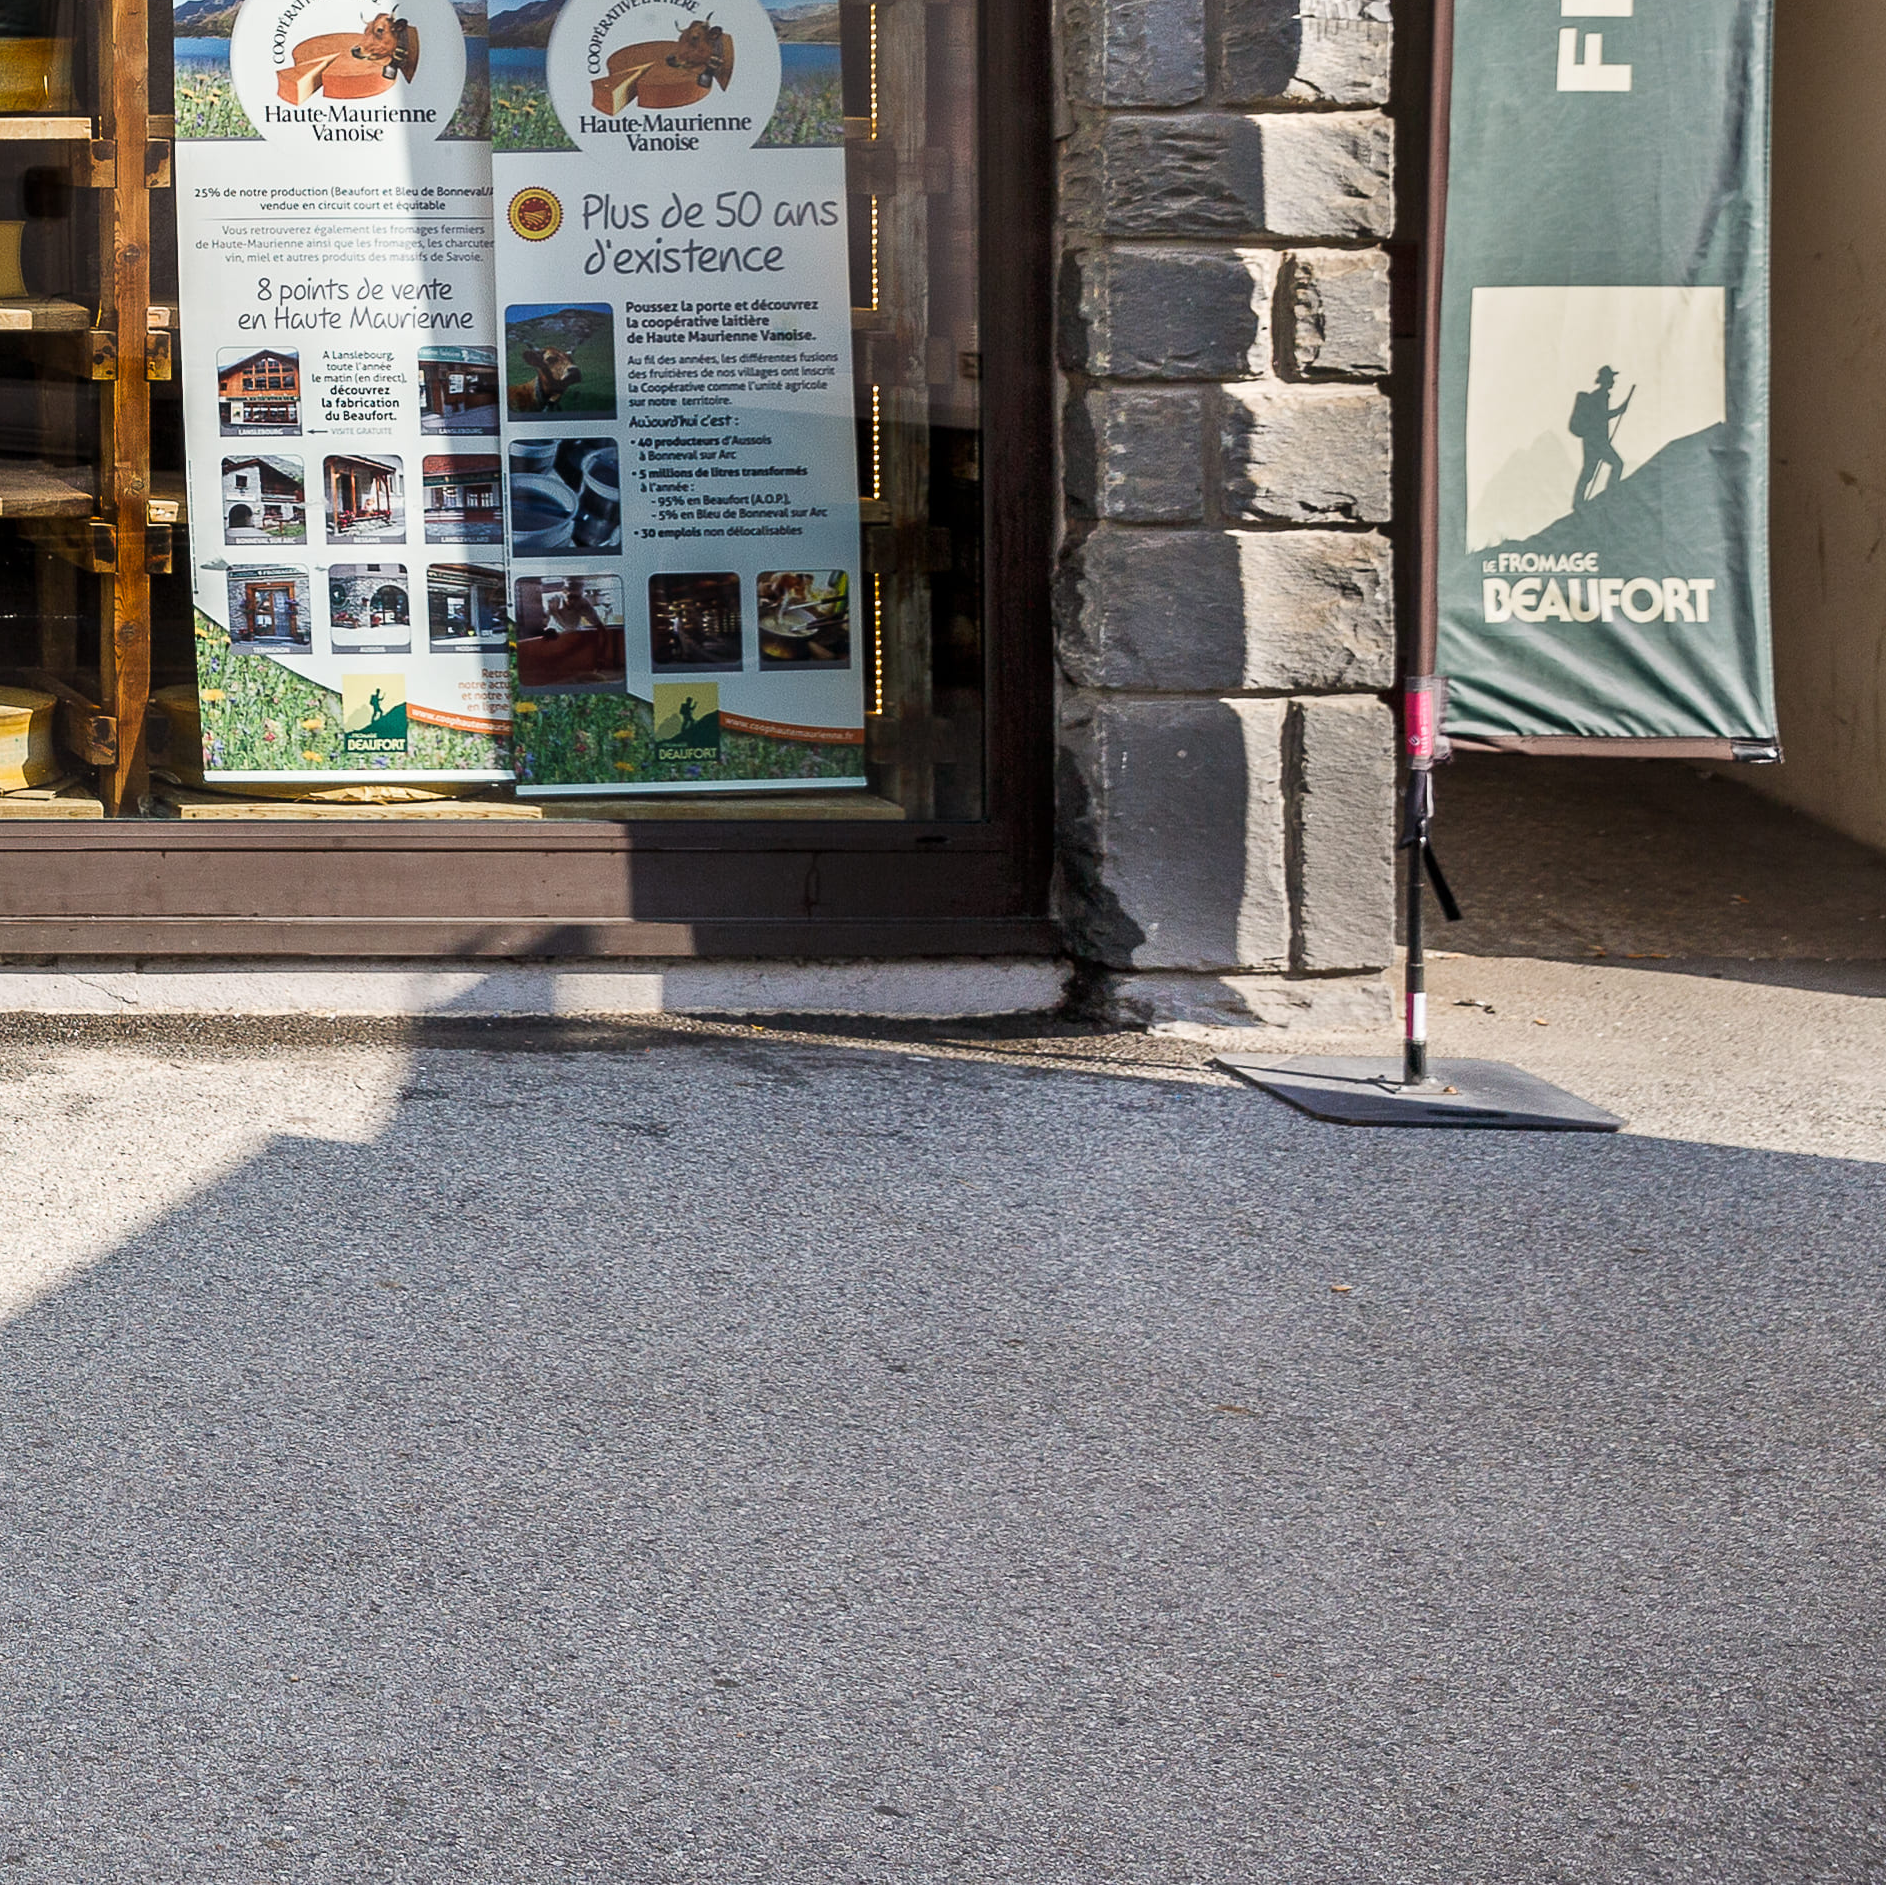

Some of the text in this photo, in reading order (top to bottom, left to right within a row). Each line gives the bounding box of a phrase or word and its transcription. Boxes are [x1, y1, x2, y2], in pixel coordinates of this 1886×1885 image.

[266, 106, 436, 122] Haute-Maurienne
[580, 115, 751, 132] Haute-Maurienne
[313, 125, 384, 141] Vanoise
[626, 135, 699, 151] Vanoise
[194, 188, 220, 197] 25%
[224, 188, 237, 197] de
[240, 189, 268, 197] notre
[271, 188, 328, 199] production
[331, 187, 379, 197] (Beaufort
[383, 188, 392, 196] et
[396, 187, 418, 196] Bleu
[421, 187, 434, 196] de
[260, 200, 445, 212] vendue en circuit court et équitable
[583, 191, 839, 230] Plus de 50 ans
[222, 224, 485, 237] Vous retrouverez également les fromages fermiers
[196, 240, 209, 249] de
[212, 239, 303, 249] Haute-Maurienne
[306, 239, 331, 248] ainsi
[334, 240, 353, 250] que
[356, 239, 371, 248] les
[374, 239, 424, 250] fromages,
[428, 238, 442, 248] les
[225, 252, 483, 264] vin, miel et autres produits des massifs de Savoie.
[584, 237, 784, 274] d'existence
[257, 277, 452, 306] 8 points de vente
[626, 299, 818, 315] Poussez la porte et découvrez
[238, 306, 473, 330] en Haute Maurienne
[627, 313, 769, 331] la coopérative laitière
[627, 330, 816, 343] de Haute Maurienne Vanoise.
[323, 350, 394, 361] A Lanslebourg,
[628, 352, 838, 365] Au fil des années, les différentes fusions
[327, 362, 391, 371] toute l'année
[312, 374, 321, 382] le
[355, 374, 370, 384] (en
[330, 385, 390, 395] découvrez
[629, 383, 638, 393] la
[641, 382, 704, 394] Coopérative
[707, 383, 745, 391] comme
[785, 380, 827, 392] agricole
[322, 398, 399, 408] la fabrication
[629, 396, 732, 407] sur notre territoire.
[325, 411, 397, 420] du Beaufort.
[629, 415, 731, 428] Aujourd'hui c'est
[638, 436, 771, 449] 40 producteurs d'Aussois
[639, 450, 736, 461] à Bonneval sur Arc
[639, 466, 807, 479] 5 millions de litres transformés
[641, 526, 802, 540] 30 emplois non délocalisables
[1483, 552, 1598, 573] LE FROMAGE
[1483, 577, 1715, 623] BEAUFORT
[347, 739, 405, 750] BEAUFORT
[659, 747, 717, 760] BEAUFORT
